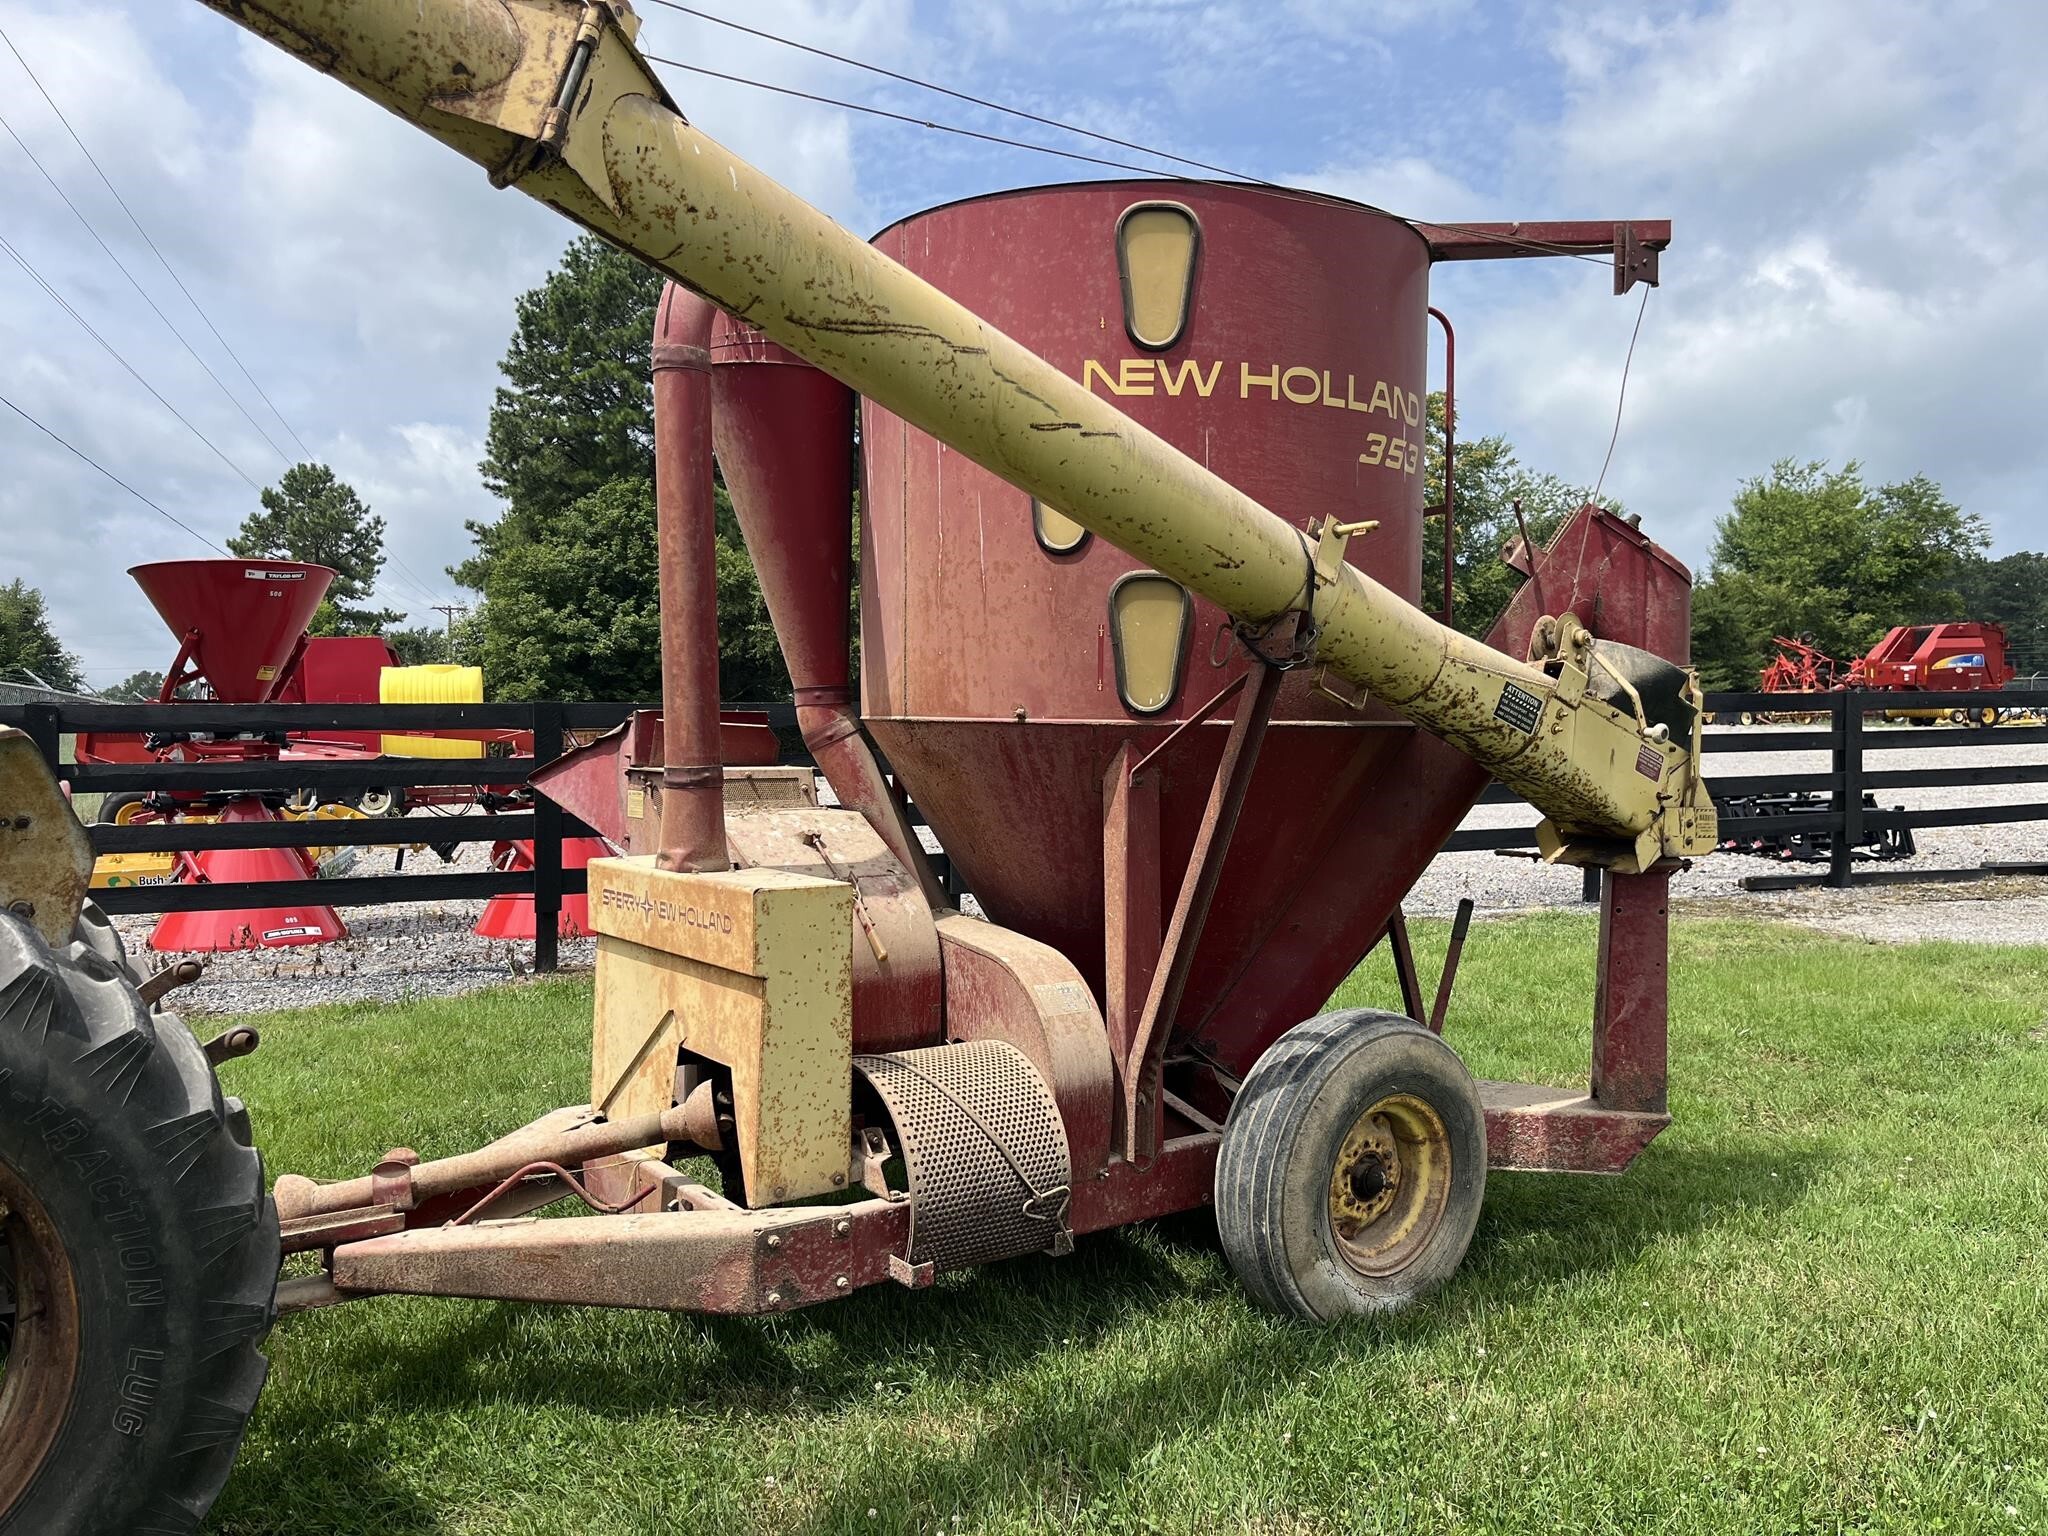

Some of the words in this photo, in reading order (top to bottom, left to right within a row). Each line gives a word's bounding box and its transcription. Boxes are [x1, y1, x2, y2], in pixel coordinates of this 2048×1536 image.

[1083, 359, 1223, 398] NEW
[1240, 361, 1420, 428] HOLLAND
[1358, 432, 1419, 475] 353
[1506, 685, 1539, 707] ATTENTION
[602, 888, 641, 912] SPERRY
[653, 899, 677, 922] NEW
[679, 902, 732, 935] HOLLAND
[112, 1346, 166, 1438] LUG
